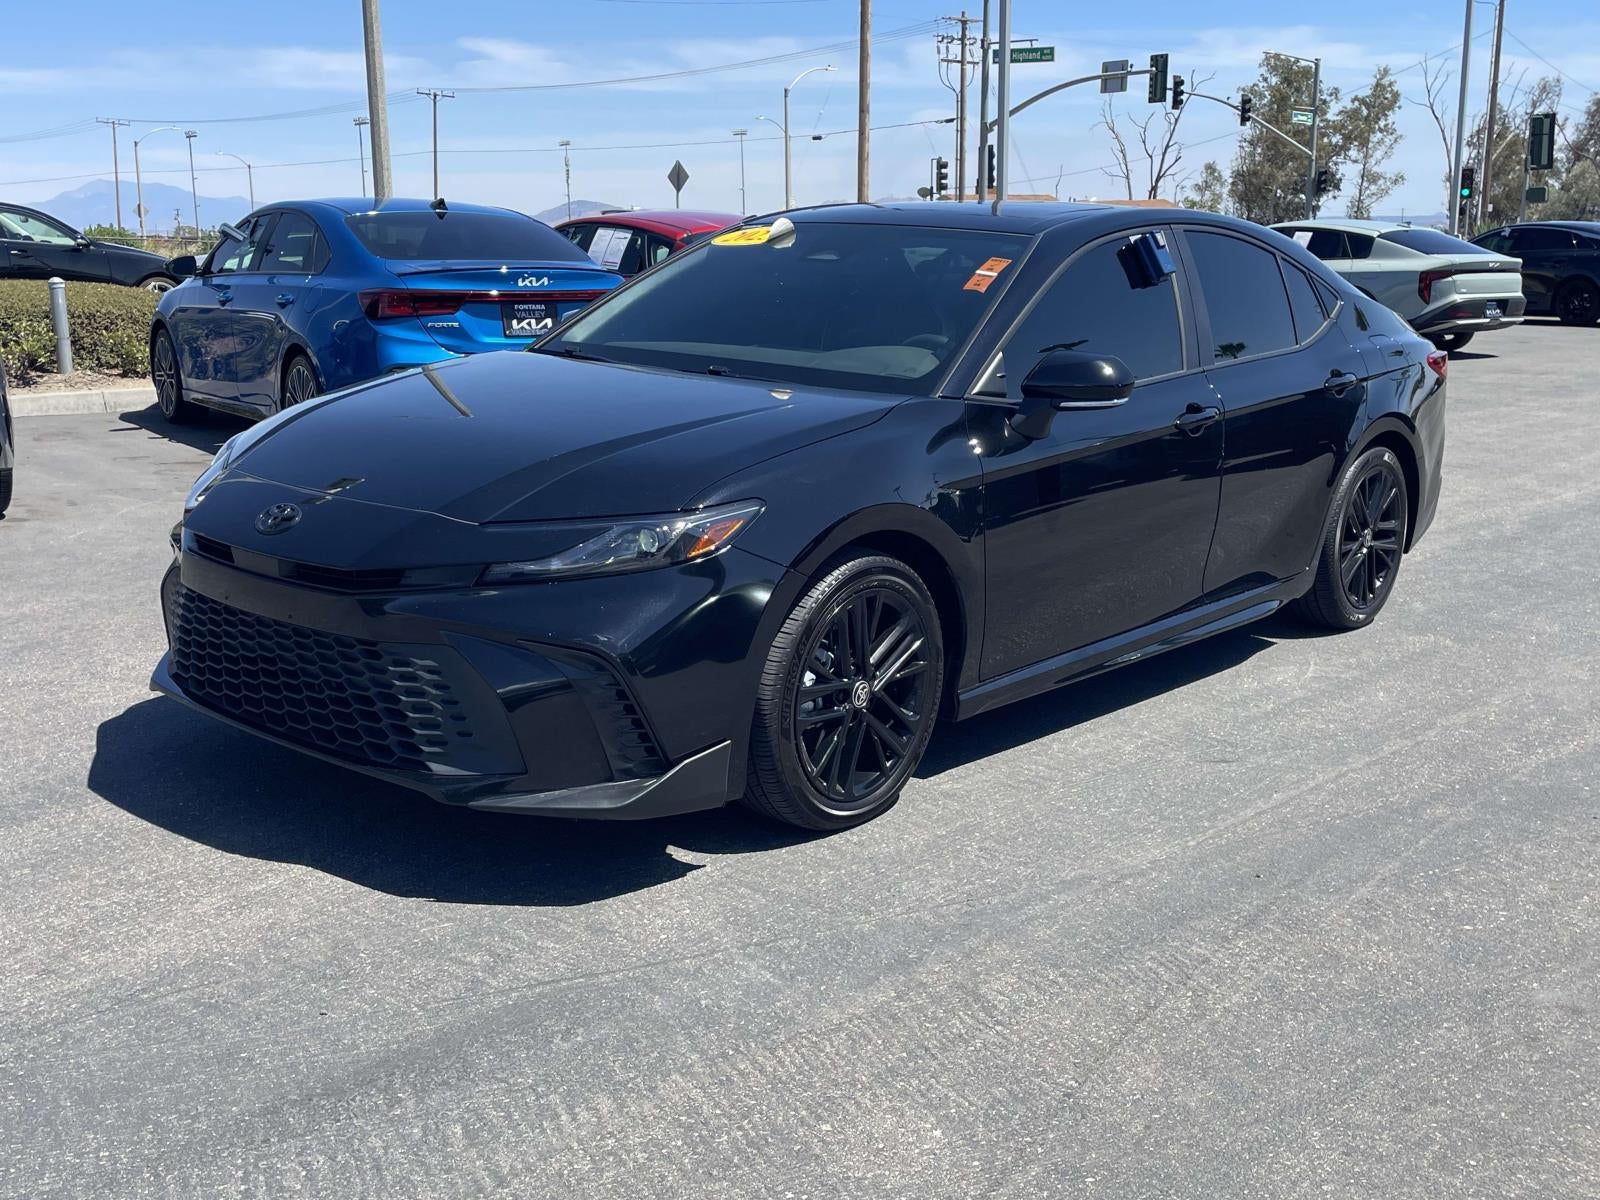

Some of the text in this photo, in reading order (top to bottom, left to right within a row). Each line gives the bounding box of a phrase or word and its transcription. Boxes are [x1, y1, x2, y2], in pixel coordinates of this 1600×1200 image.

[1012, 51, 1040, 62] Highland
[517, 276, 549, 287] KIA
[511, 318, 553, 330] KIA
